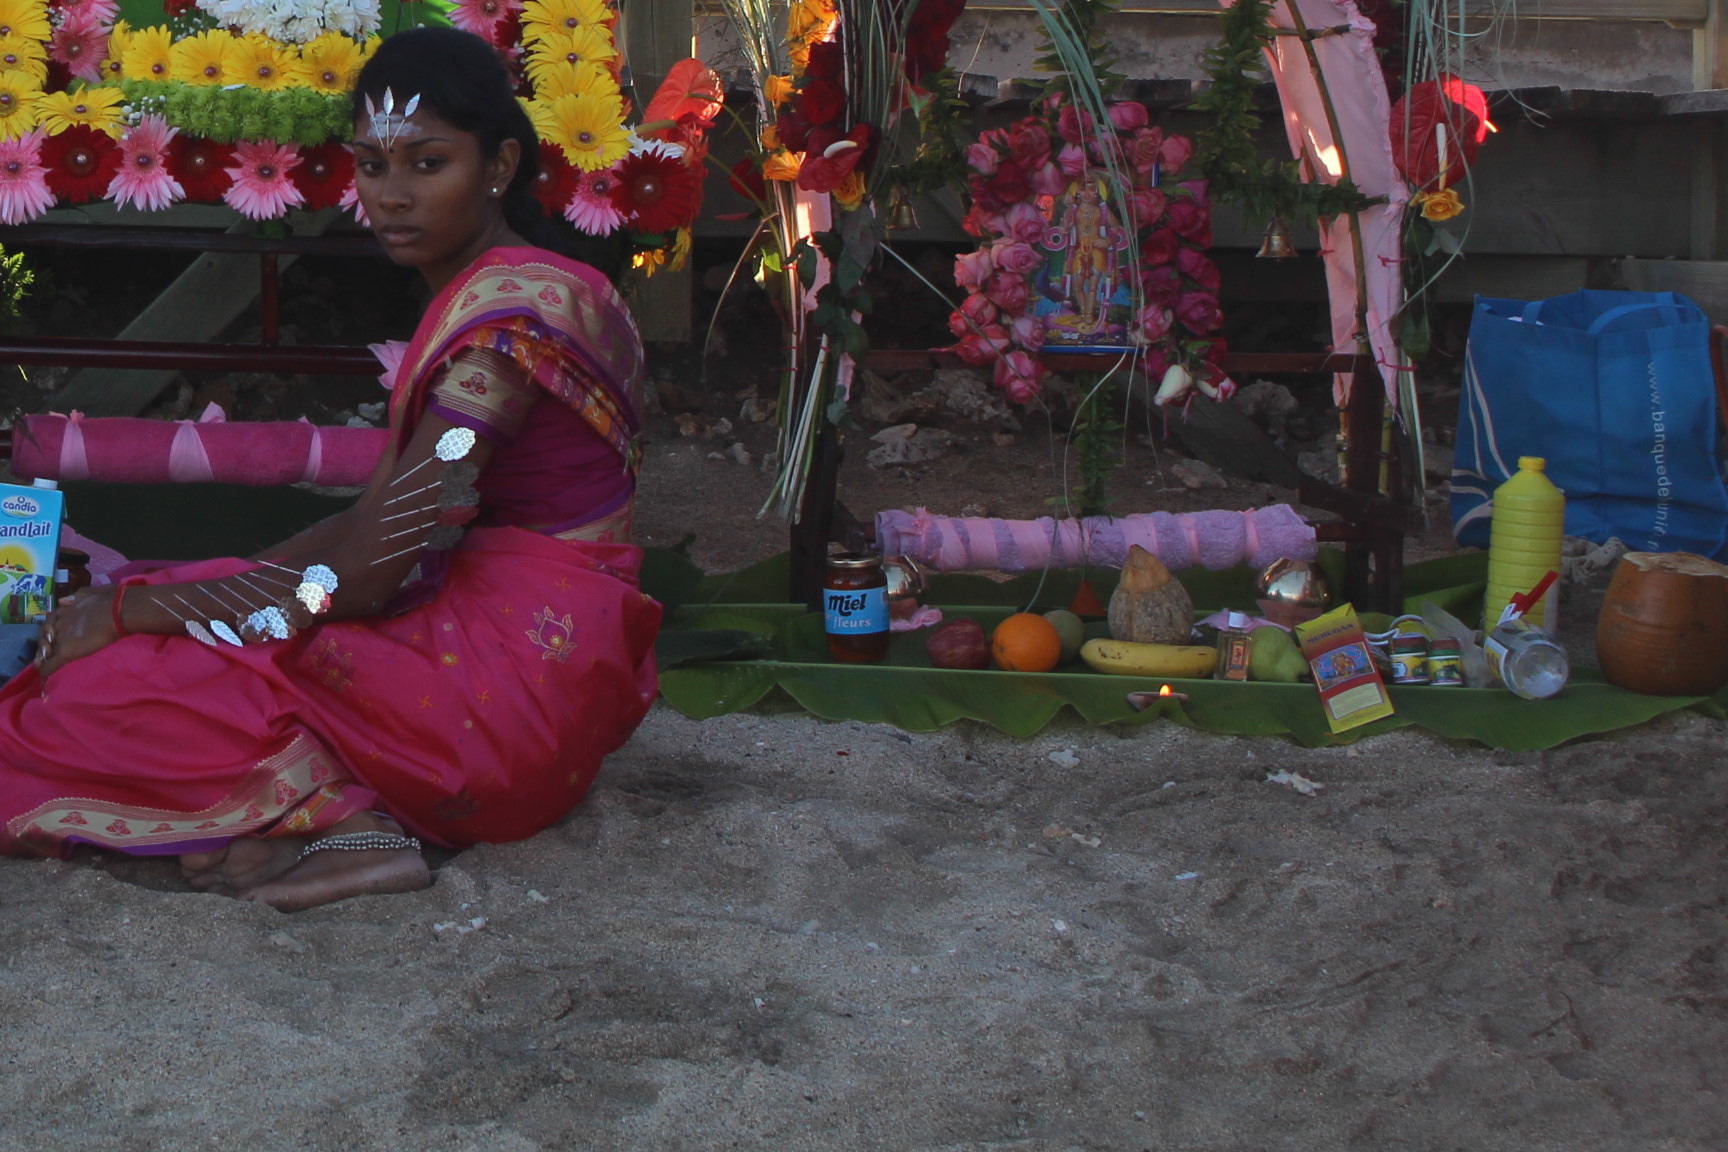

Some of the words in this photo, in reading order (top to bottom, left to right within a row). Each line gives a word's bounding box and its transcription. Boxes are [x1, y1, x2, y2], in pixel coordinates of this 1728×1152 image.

[3, 501, 37, 513] candia
[829, 593, 867, 617] Miel
[833, 617, 872, 629] fleurs
